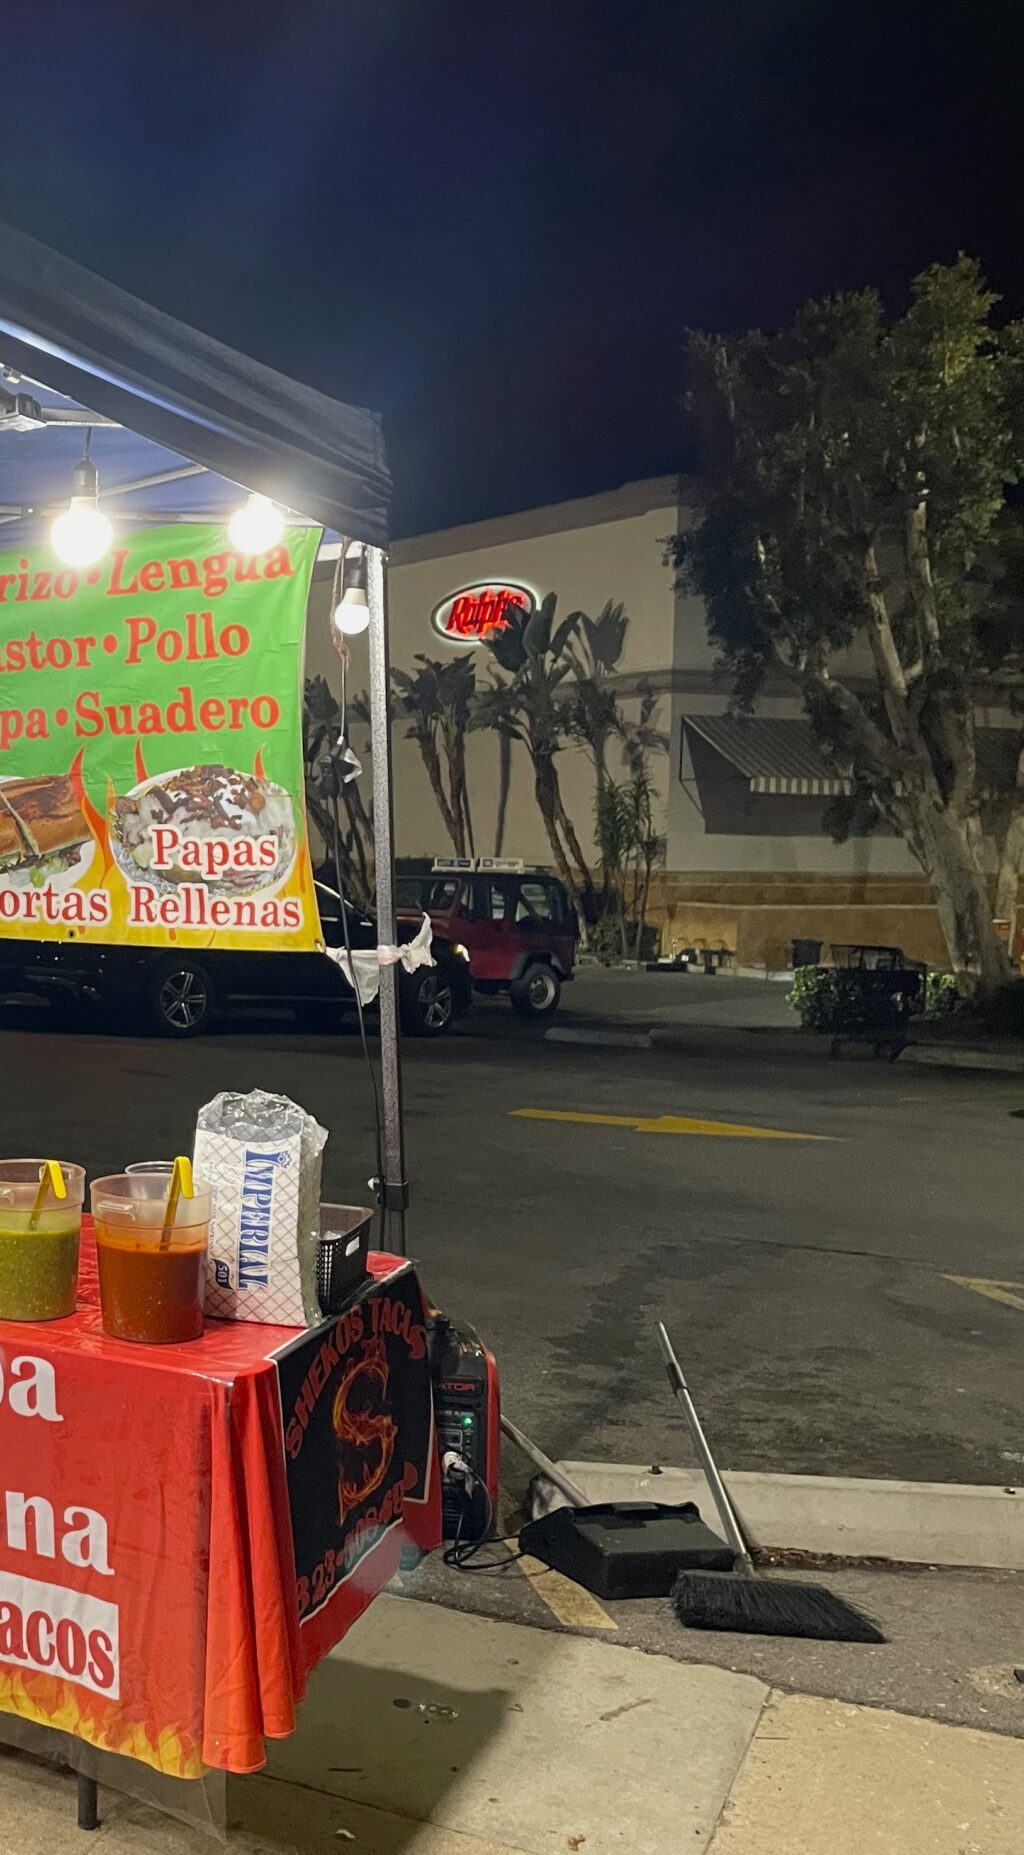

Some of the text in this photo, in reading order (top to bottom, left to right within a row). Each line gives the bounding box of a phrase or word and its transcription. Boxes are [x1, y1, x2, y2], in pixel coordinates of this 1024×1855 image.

[107, 545, 294, 598] Lengua
[124, 612, 251, 664] Pollo
[74, 686, 281, 738] Suadero
[154, 829, 277, 875] Papas
[131, 886, 301, 928] Rellenas
[217, 1263, 228, 1284] 501
